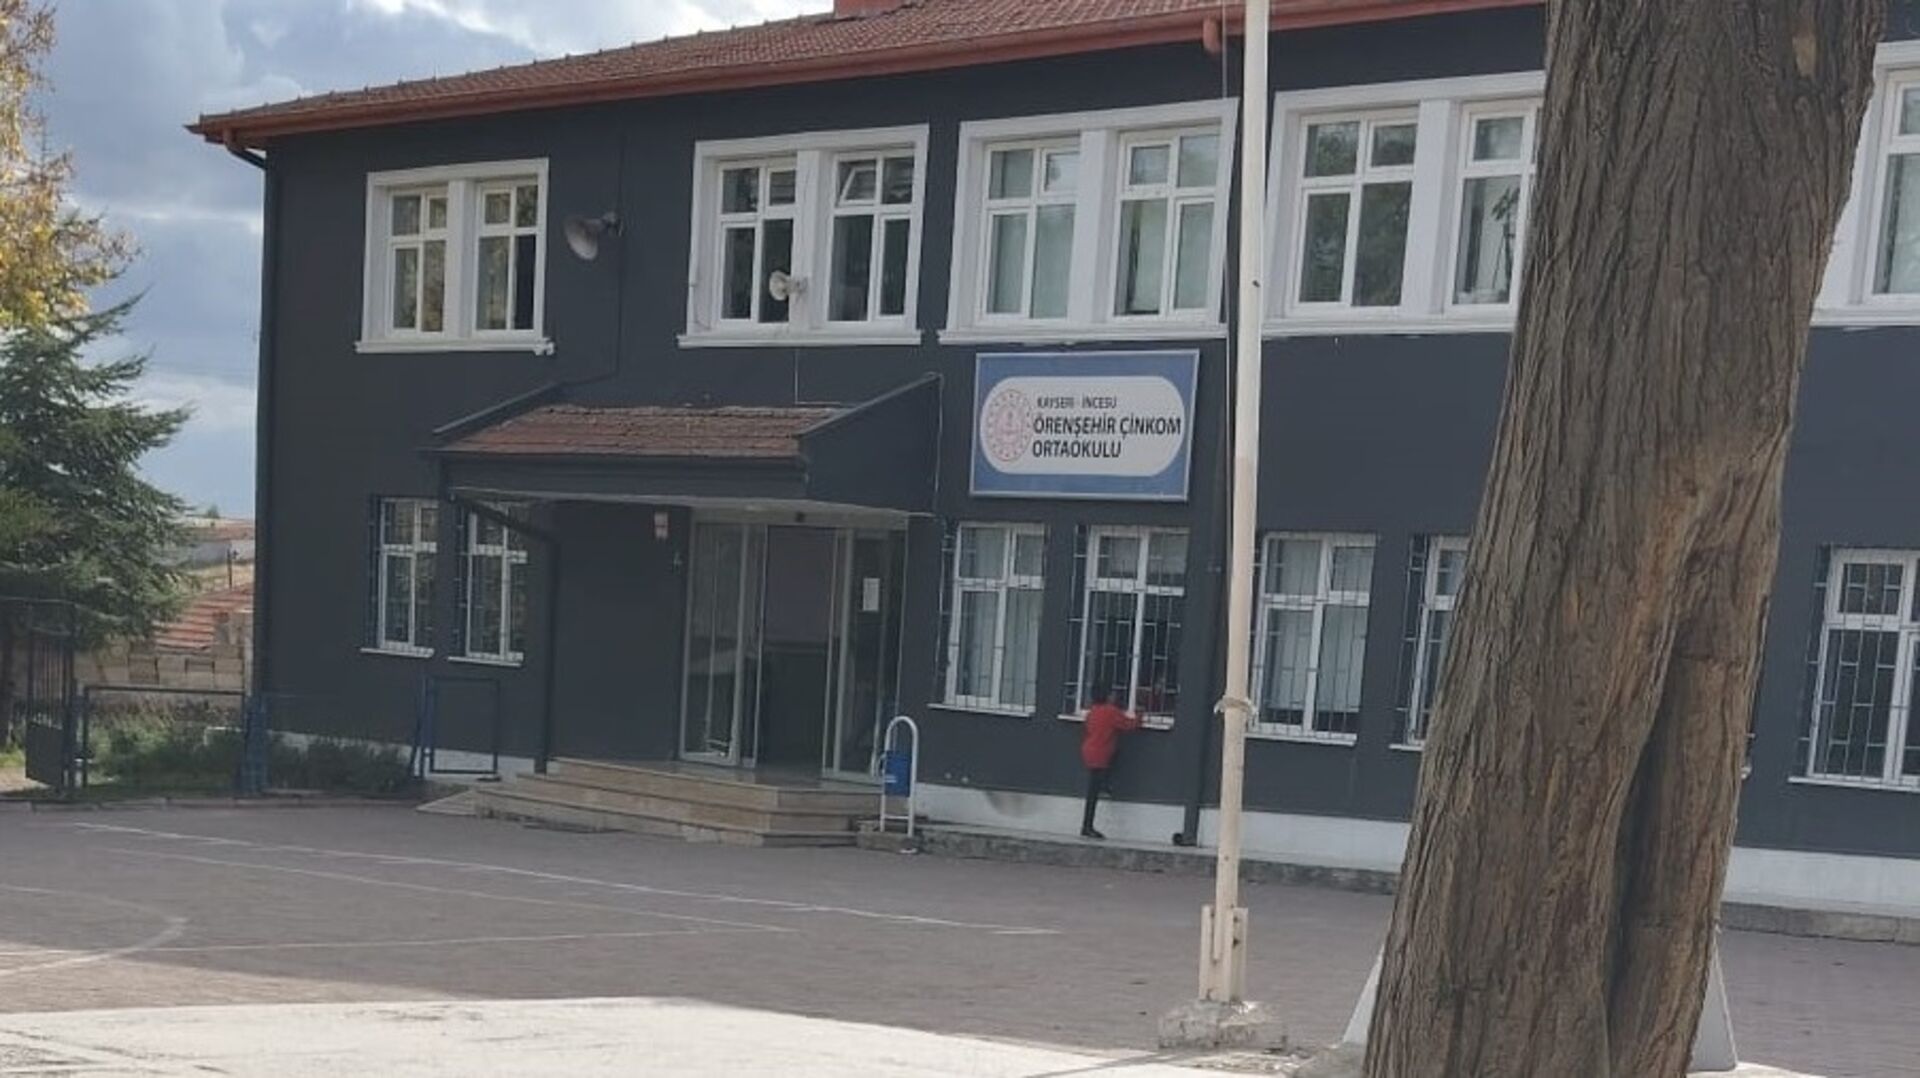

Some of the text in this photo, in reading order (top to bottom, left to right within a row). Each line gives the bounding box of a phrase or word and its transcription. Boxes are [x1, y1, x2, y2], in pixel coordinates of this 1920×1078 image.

[1034, 411, 1181, 440] ÖRENŞEHİR ÇİNKOM
[1033, 440, 1121, 458] ORTAOKULU
